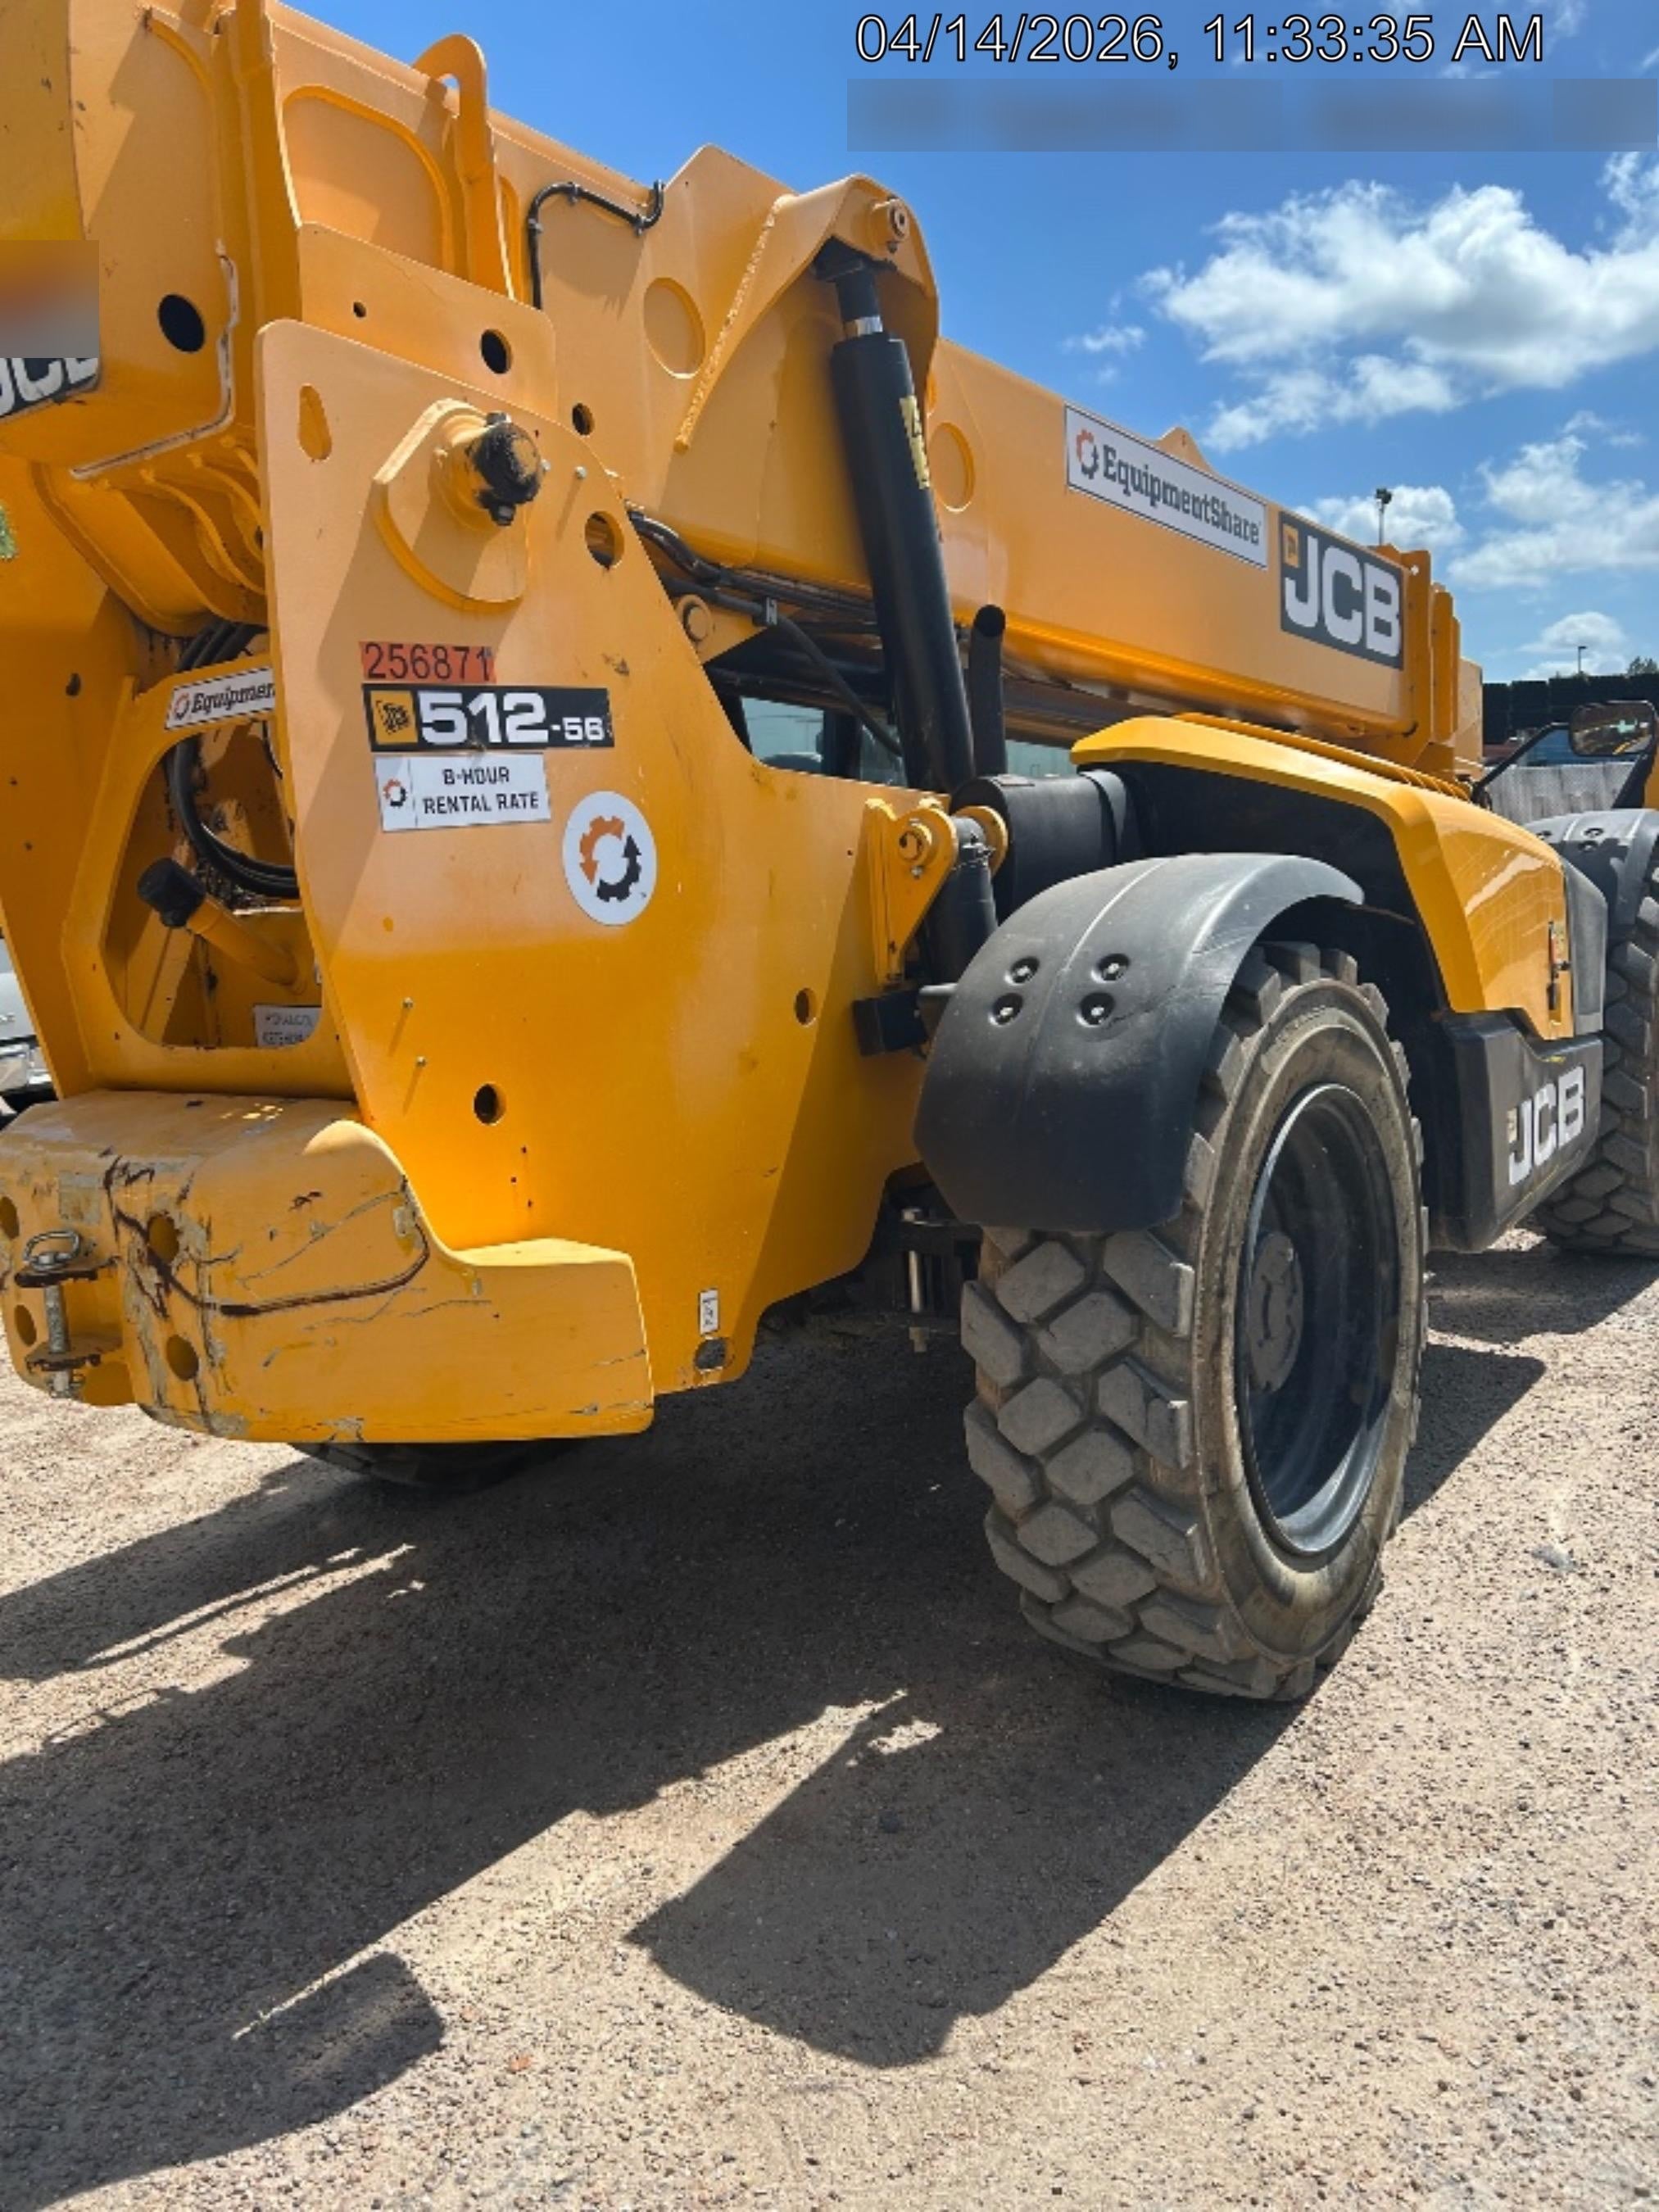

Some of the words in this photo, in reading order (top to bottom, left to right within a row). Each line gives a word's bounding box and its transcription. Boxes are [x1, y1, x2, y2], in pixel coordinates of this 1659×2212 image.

[1103, 444, 1259, 546] EquipmentShare
[1285, 535, 1401, 657] JCB
[365, 641, 492, 680] 256871
[418, 691, 605, 744] 512-56
[423, 795, 492, 815] RENTAL
[496, 791, 539, 810] RATE
[1509, 1066, 1584, 1185] JCB
